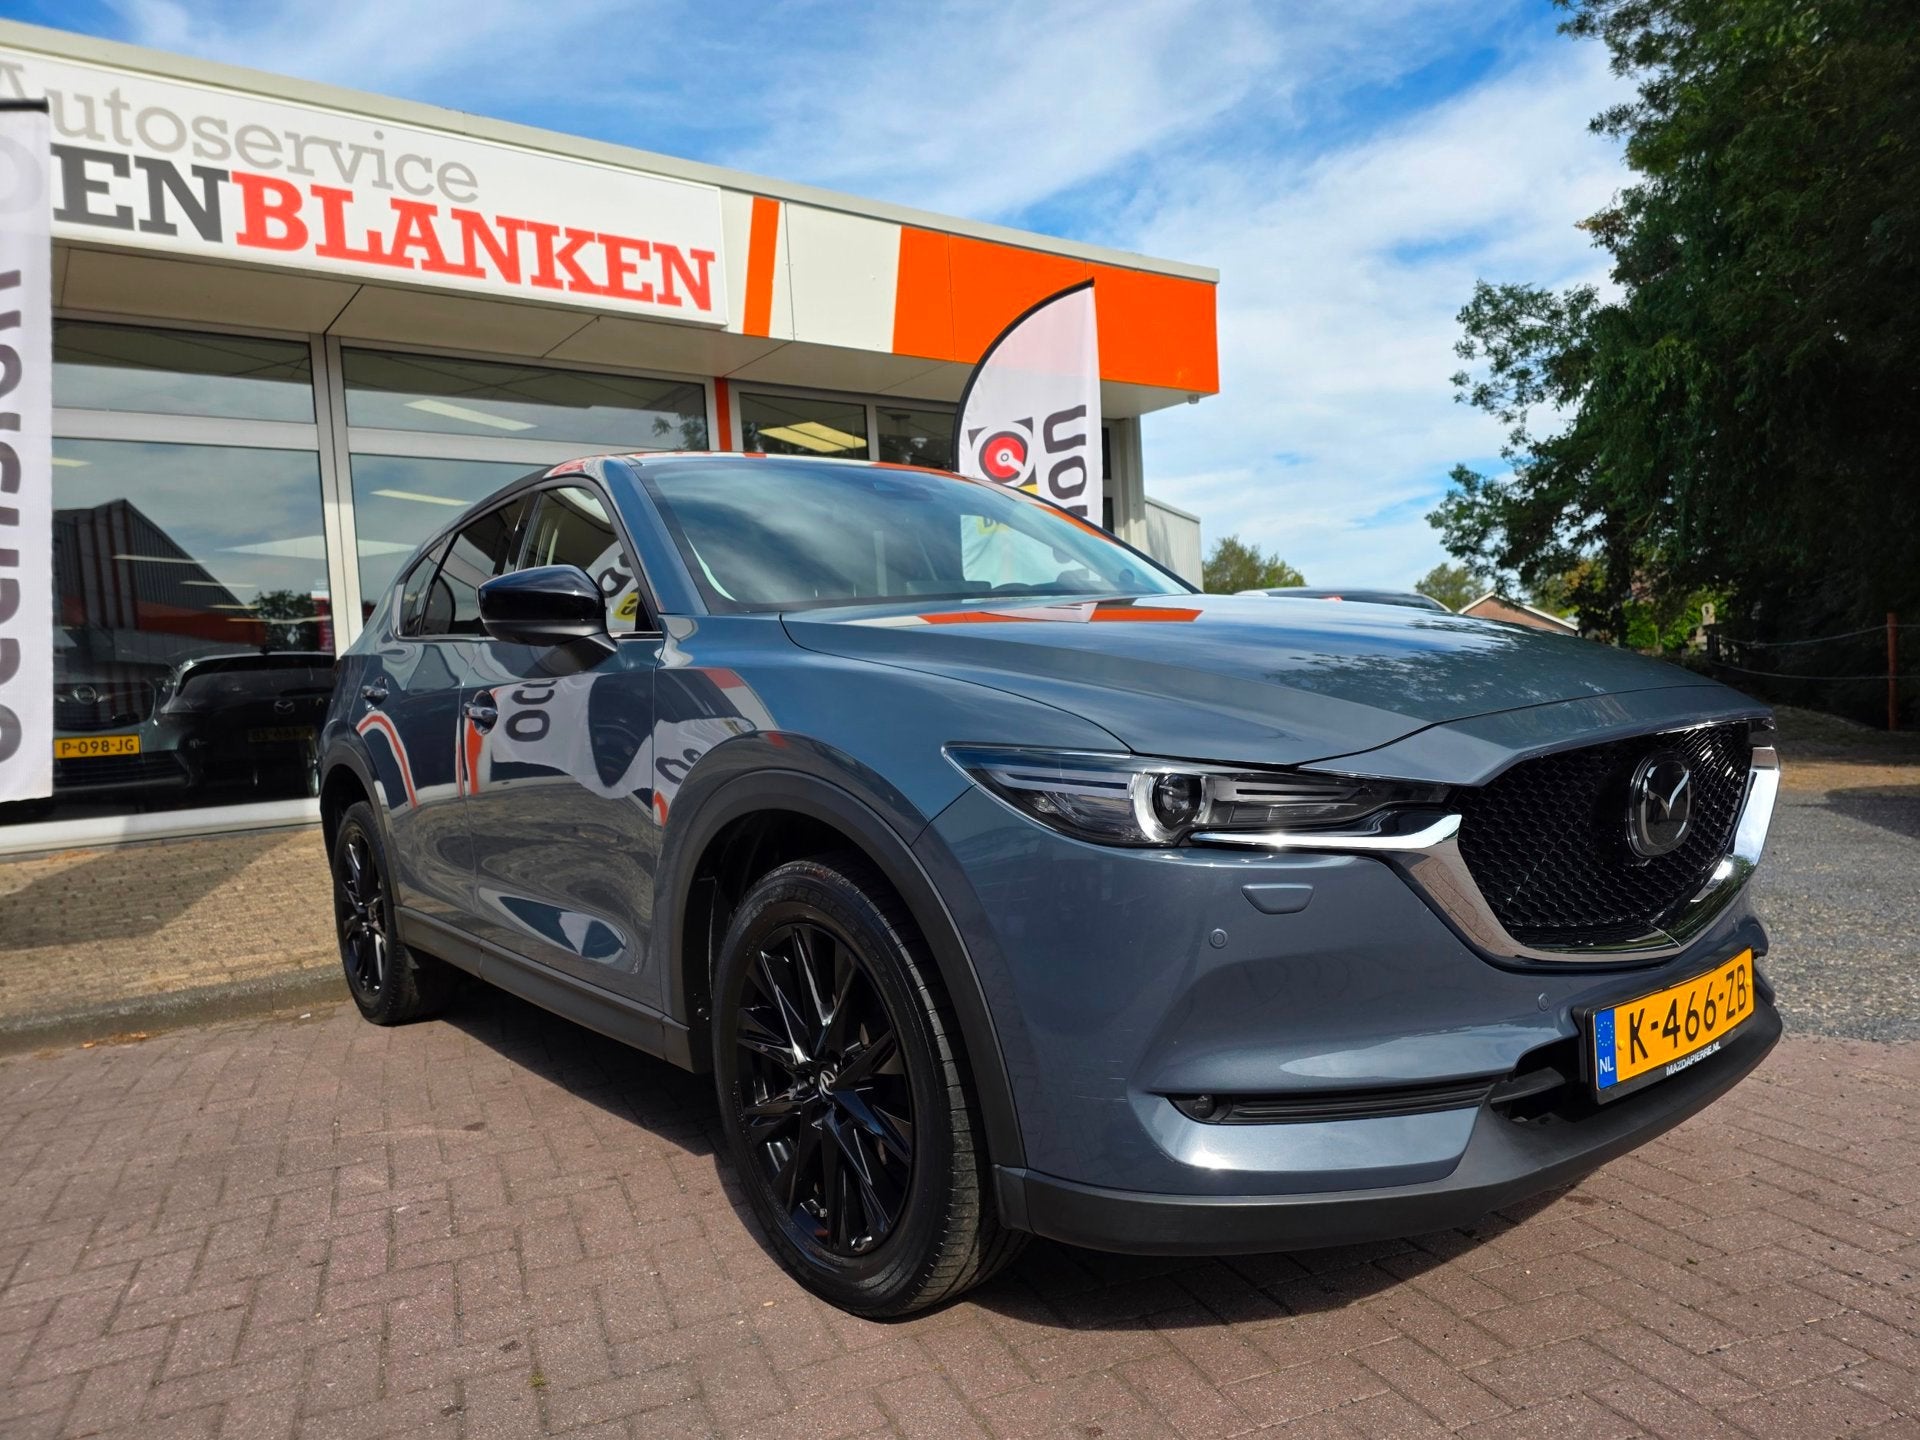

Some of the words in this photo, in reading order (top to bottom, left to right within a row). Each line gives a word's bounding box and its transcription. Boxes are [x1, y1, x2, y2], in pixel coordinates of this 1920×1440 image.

[61, 738, 134, 755] P-098-JG
[1629, 964, 1747, 1065] K-466-ZB
[1600, 1056, 1614, 1074] NL
[1666, 1041, 1721, 1076] MAZDAPIERRE.NL
